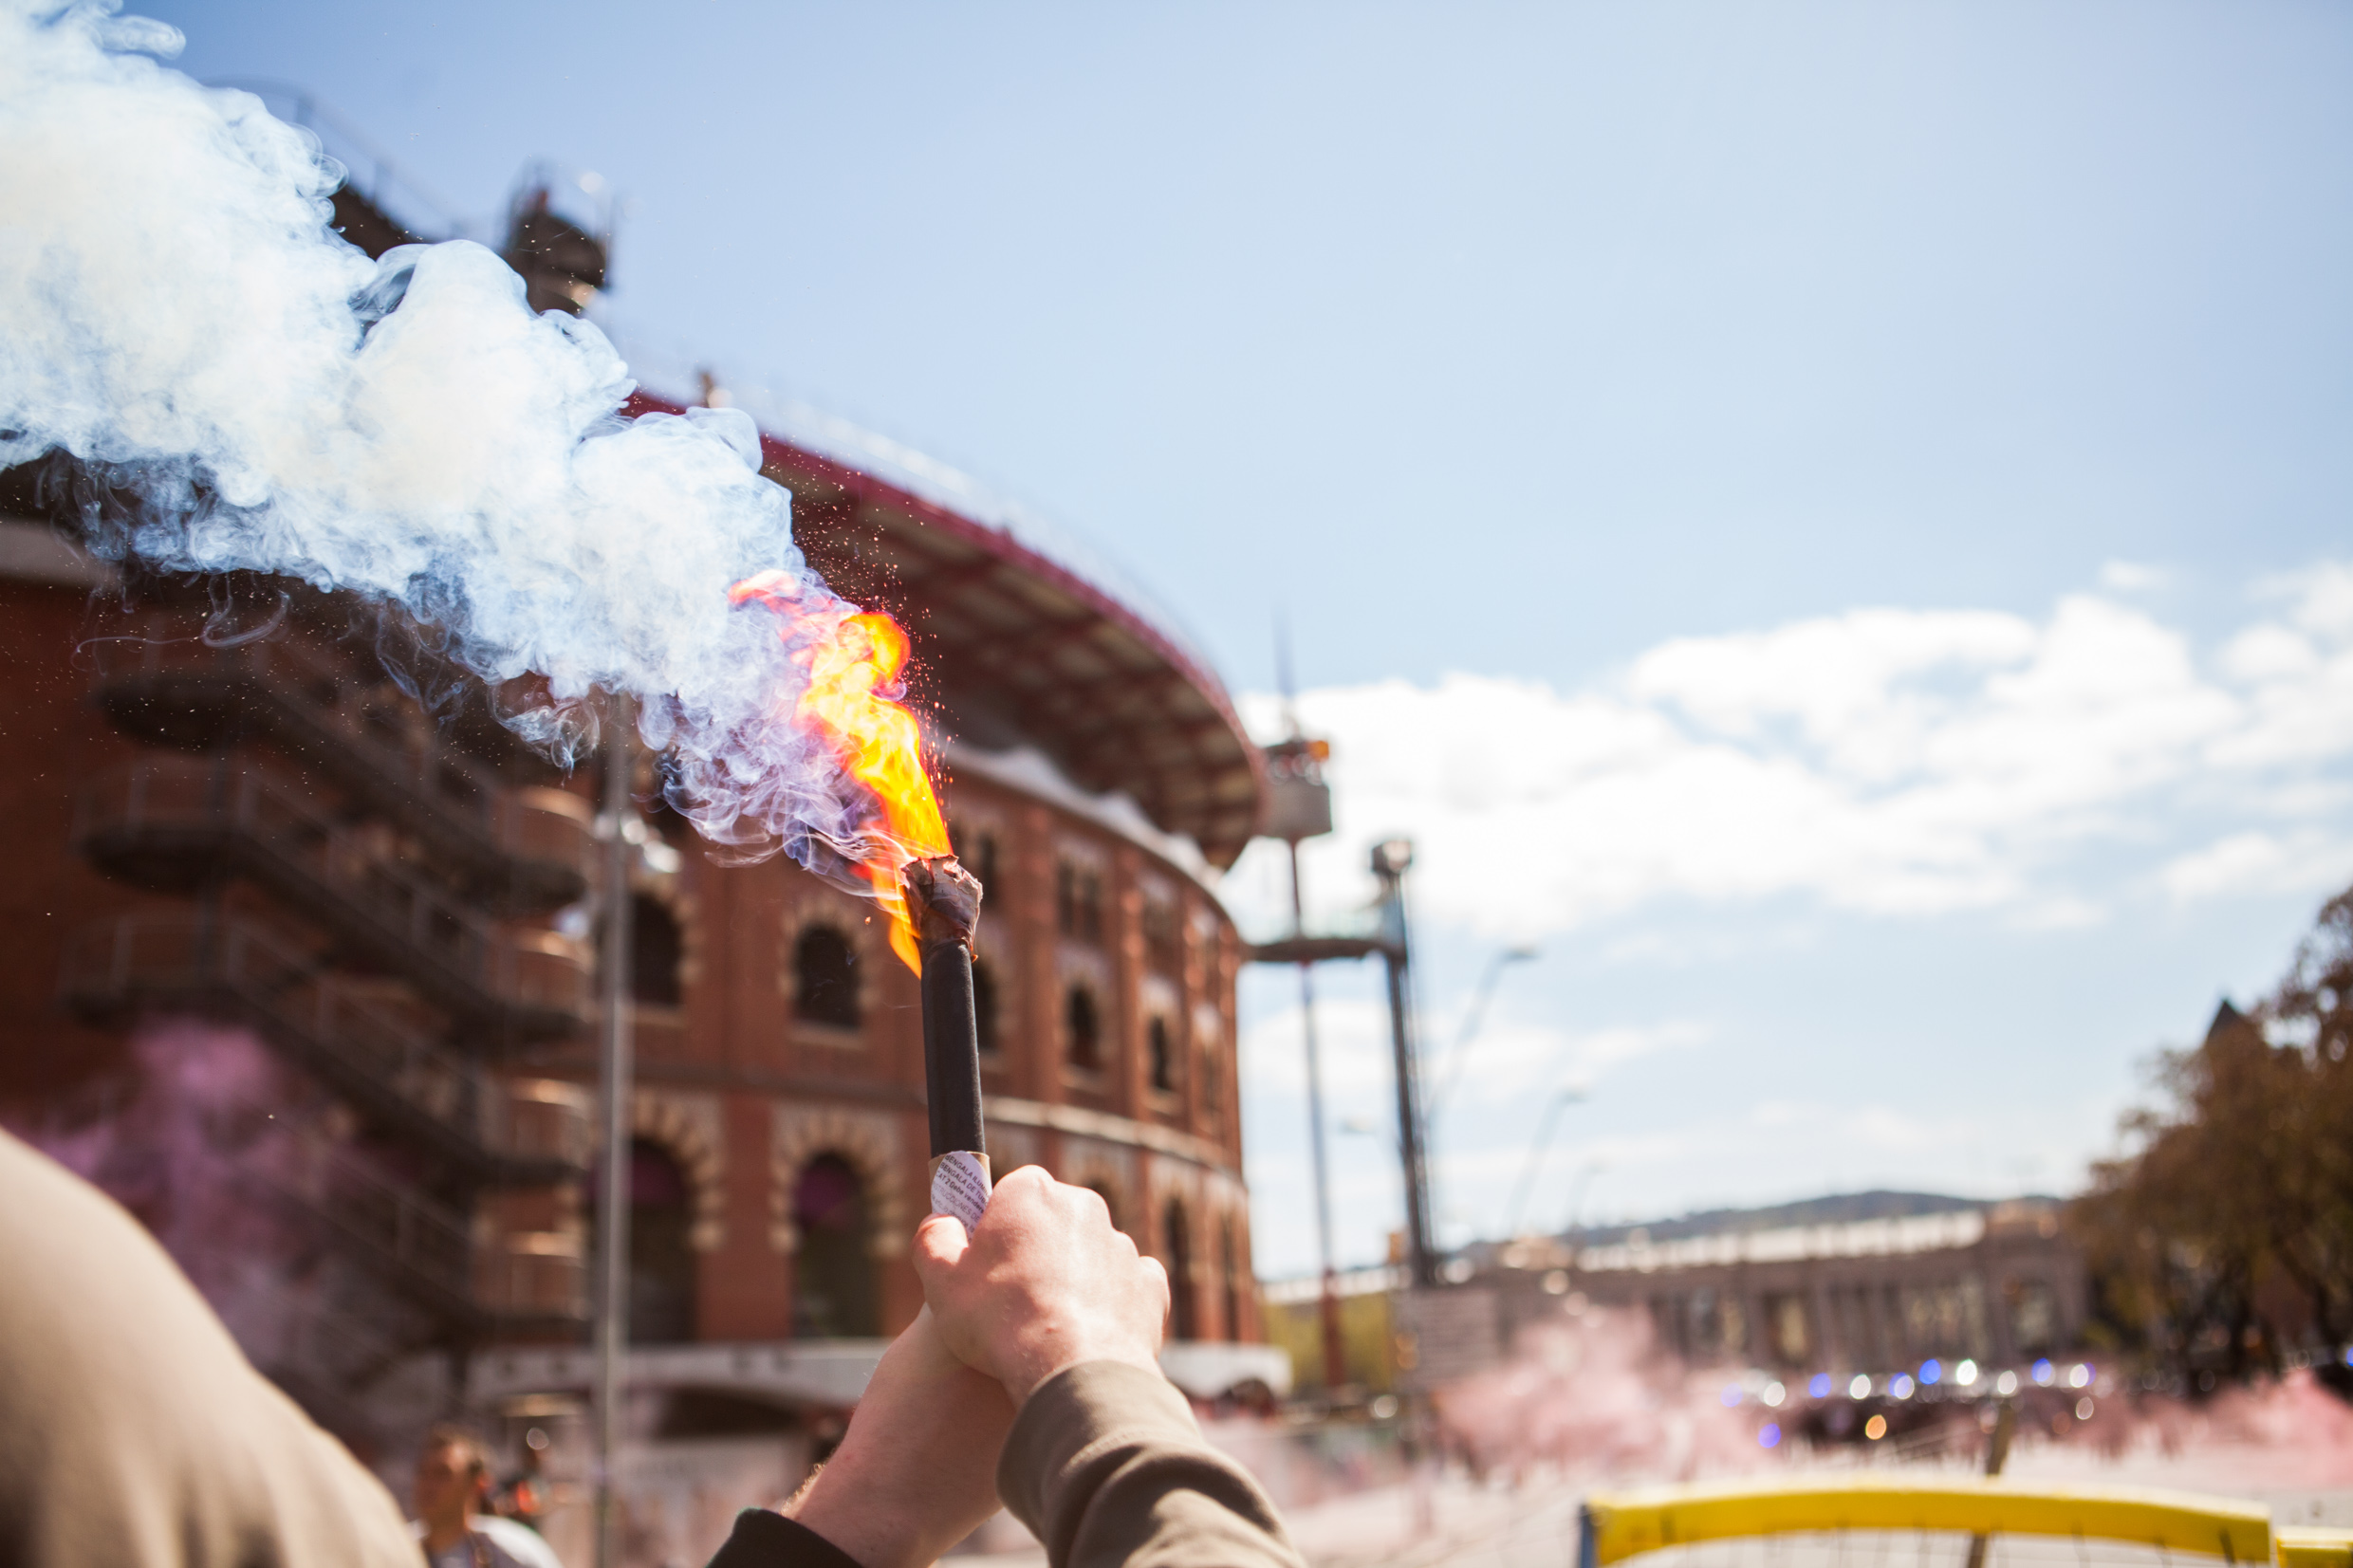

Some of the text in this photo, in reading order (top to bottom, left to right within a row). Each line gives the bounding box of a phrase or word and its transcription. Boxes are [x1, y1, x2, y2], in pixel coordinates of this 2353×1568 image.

[944, 1154, 973, 1178] BENGALA
[939, 1162, 967, 1185] BENGALA
[966, 1182, 976, 1193] DE
[949, 1181, 964, 1195] Debe
[970, 1211, 981, 1223] DE
